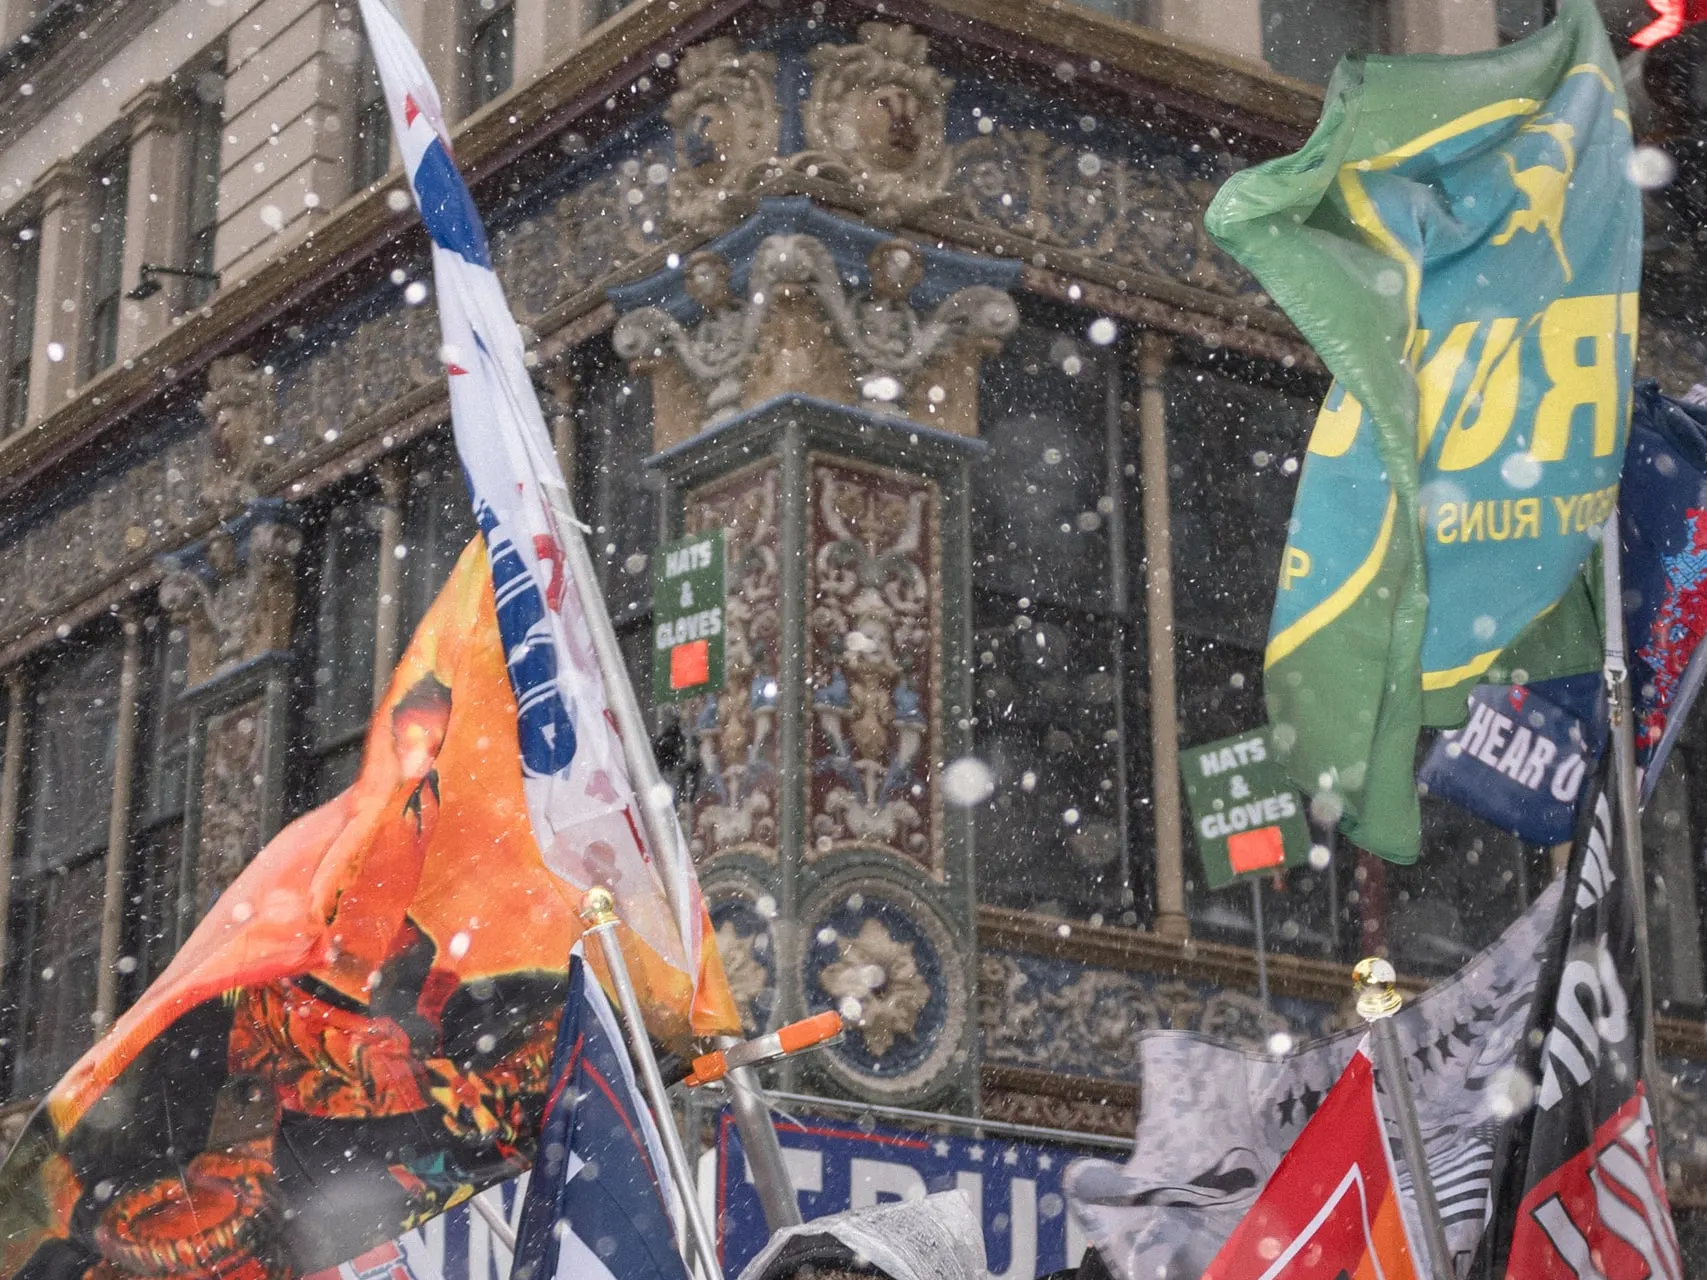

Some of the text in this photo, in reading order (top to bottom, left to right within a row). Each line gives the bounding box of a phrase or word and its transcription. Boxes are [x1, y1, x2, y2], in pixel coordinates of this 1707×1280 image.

[666, 540, 712, 578] HATS
[656, 607, 722, 650] GLOVES
[1200, 737, 1266, 777] HATS
[1460, 702, 1557, 791] HEAR
[1230, 775, 1250, 799] &
[1201, 792, 1296, 839] GLOVES
